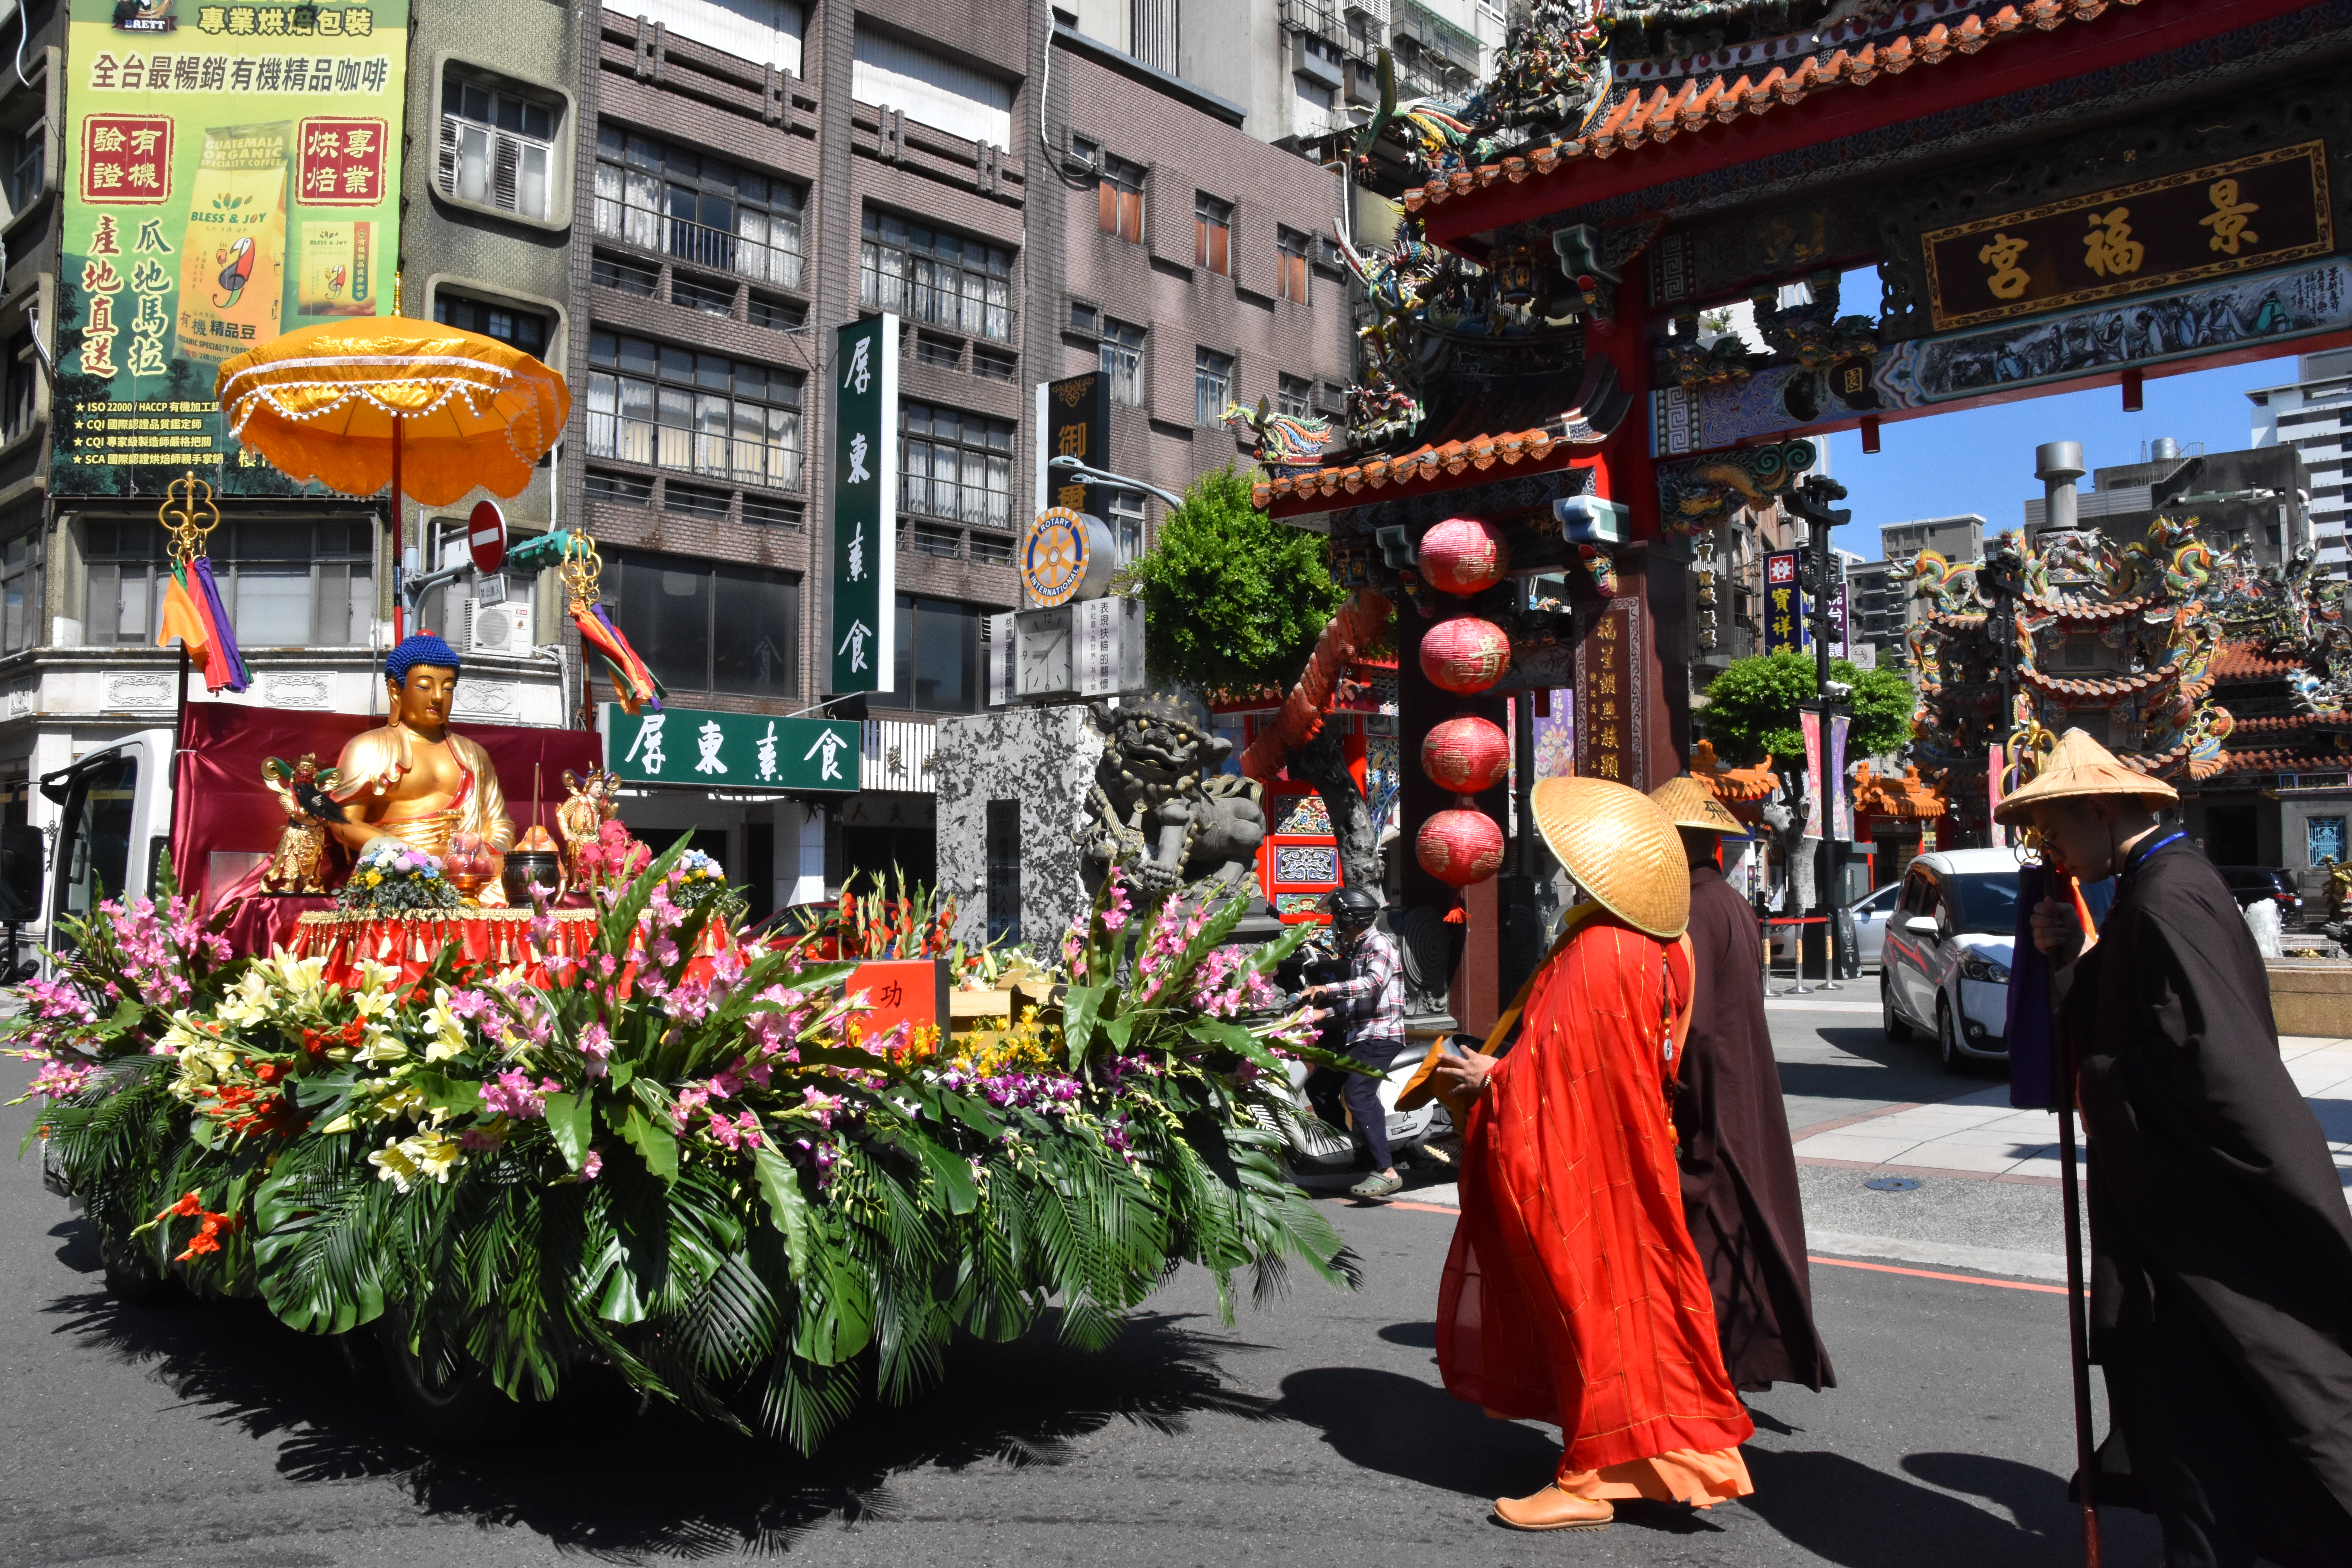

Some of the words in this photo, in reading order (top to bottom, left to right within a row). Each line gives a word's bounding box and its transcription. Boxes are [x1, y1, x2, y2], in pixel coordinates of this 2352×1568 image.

[124, 19, 166, 29] BRETT
[199, 6, 373, 36] 專業烘焙包裝
[92, 54, 387, 92] 全台最暢銷有機精品咖啡
[205, 136, 283, 150] GUATEMALA
[203, 147, 282, 159] ORGANIC
[191, 212, 225, 223] BLESS
[229, 214, 238, 223] &
[243, 213, 267, 224] JOY
[83, 215, 122, 376] 產地直送
[129, 218, 173, 374] 瓜地馬拉
[210, 319, 256, 340] 精品豆
[178, 334, 197, 346] ORGANIC
[199, 341, 229, 352] SPECIALTY
[88, 402, 105, 412] ISO
[107, 402, 132, 412] 22000
[139, 402, 167, 412] HACCP
[87, 419, 105, 430] CQI
[107, 419, 201, 430] 國際認證品質鑑定師
[86, 437, 104, 447] CQI
[107, 436, 211, 447] 專家級製造師嚴格把關
[85, 454, 105, 464] SCA
[107, 454, 223, 465] 國際認證烘焙師親手掌鍋
[838, 336, 871, 673] 屏東素食
[1040, 517, 1069, 532] ROTARY
[1030, 568, 1078, 596] INTERNATIONAL
[481, 585, 500, 598] 禁止進入
[1044, 613, 1052, 624] 12
[1100, 602, 1109, 690] 表現扶輪的關懷
[1023, 650, 1027, 661] 9
[1468, 633, 1507, 683] 貴
[1045, 681, 1050, 691] 6
[626, 714, 847, 782] 屏東素食
[880, 980, 902, 1008] 功
